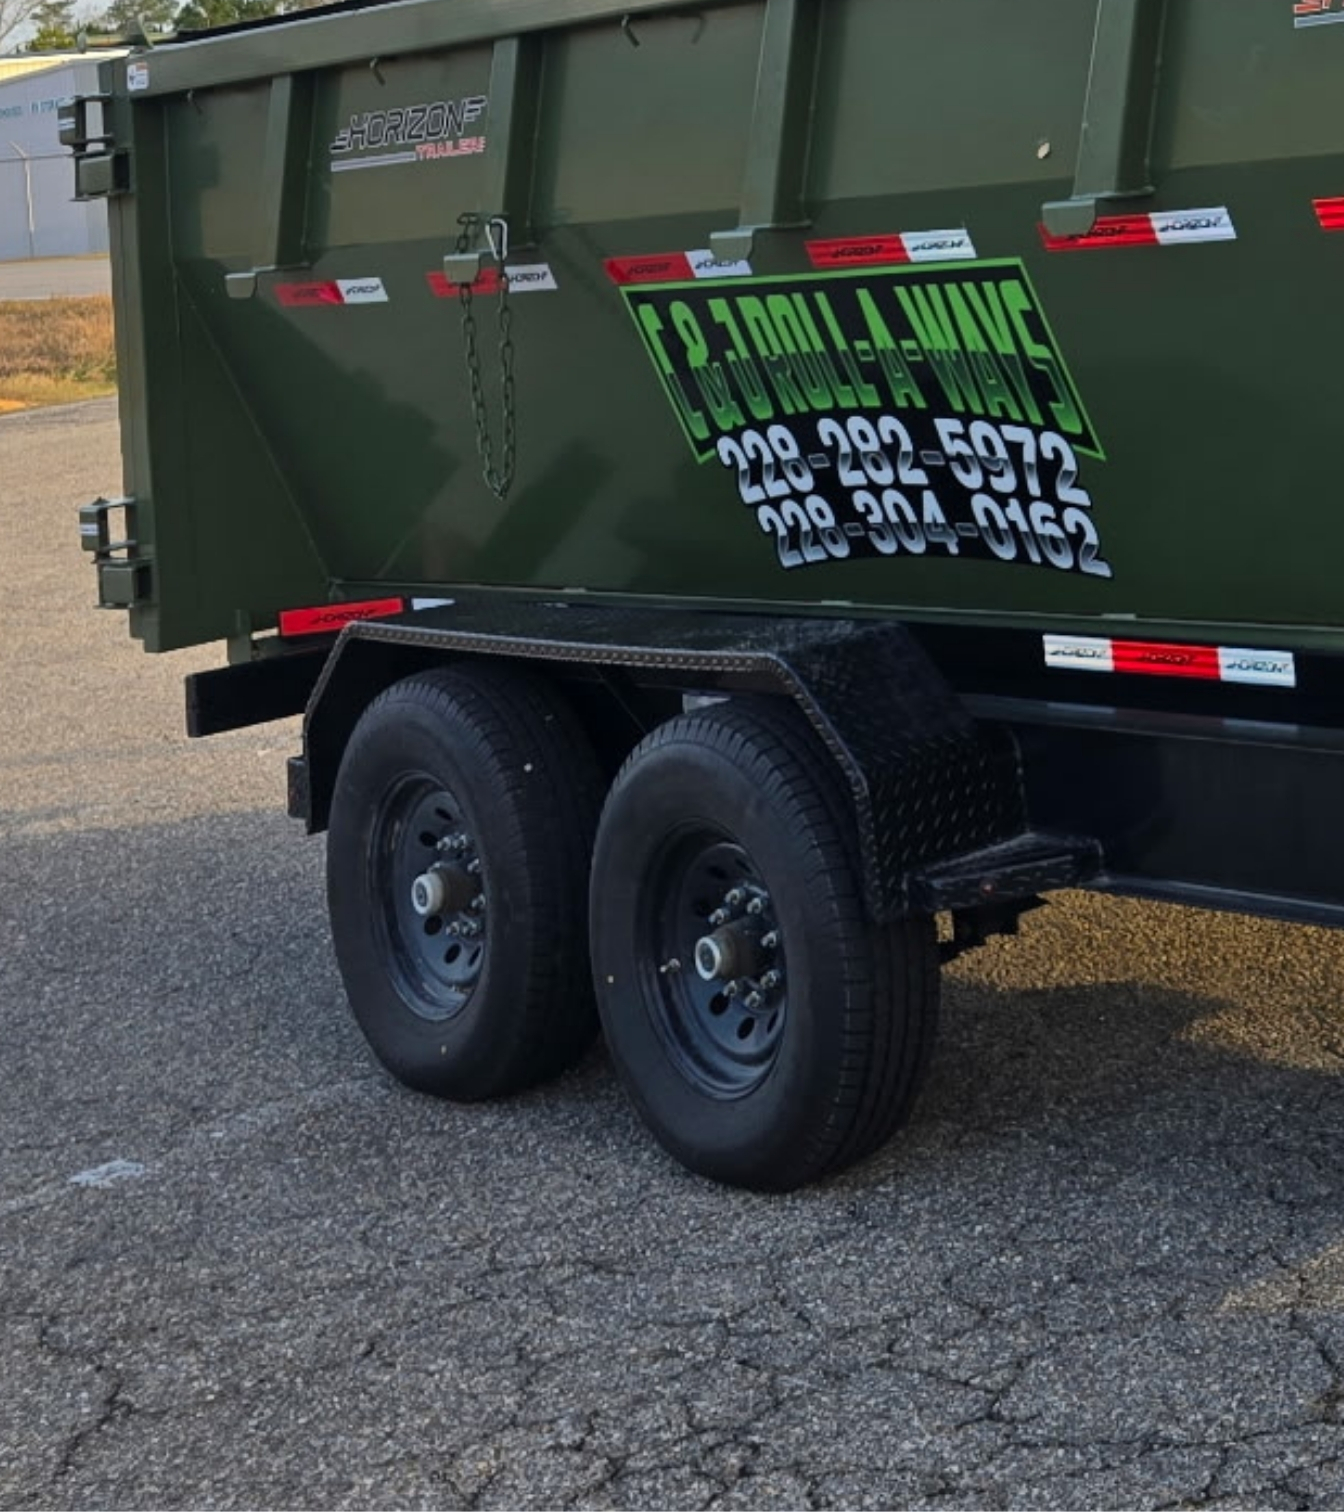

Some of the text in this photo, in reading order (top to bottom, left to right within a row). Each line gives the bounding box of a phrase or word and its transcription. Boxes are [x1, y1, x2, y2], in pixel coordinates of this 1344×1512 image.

[338, 97, 480, 152] HORIZON
[717, 415, 1092, 507] 228-282-5972
[758, 488, 1112, 578] 228-304-0162
